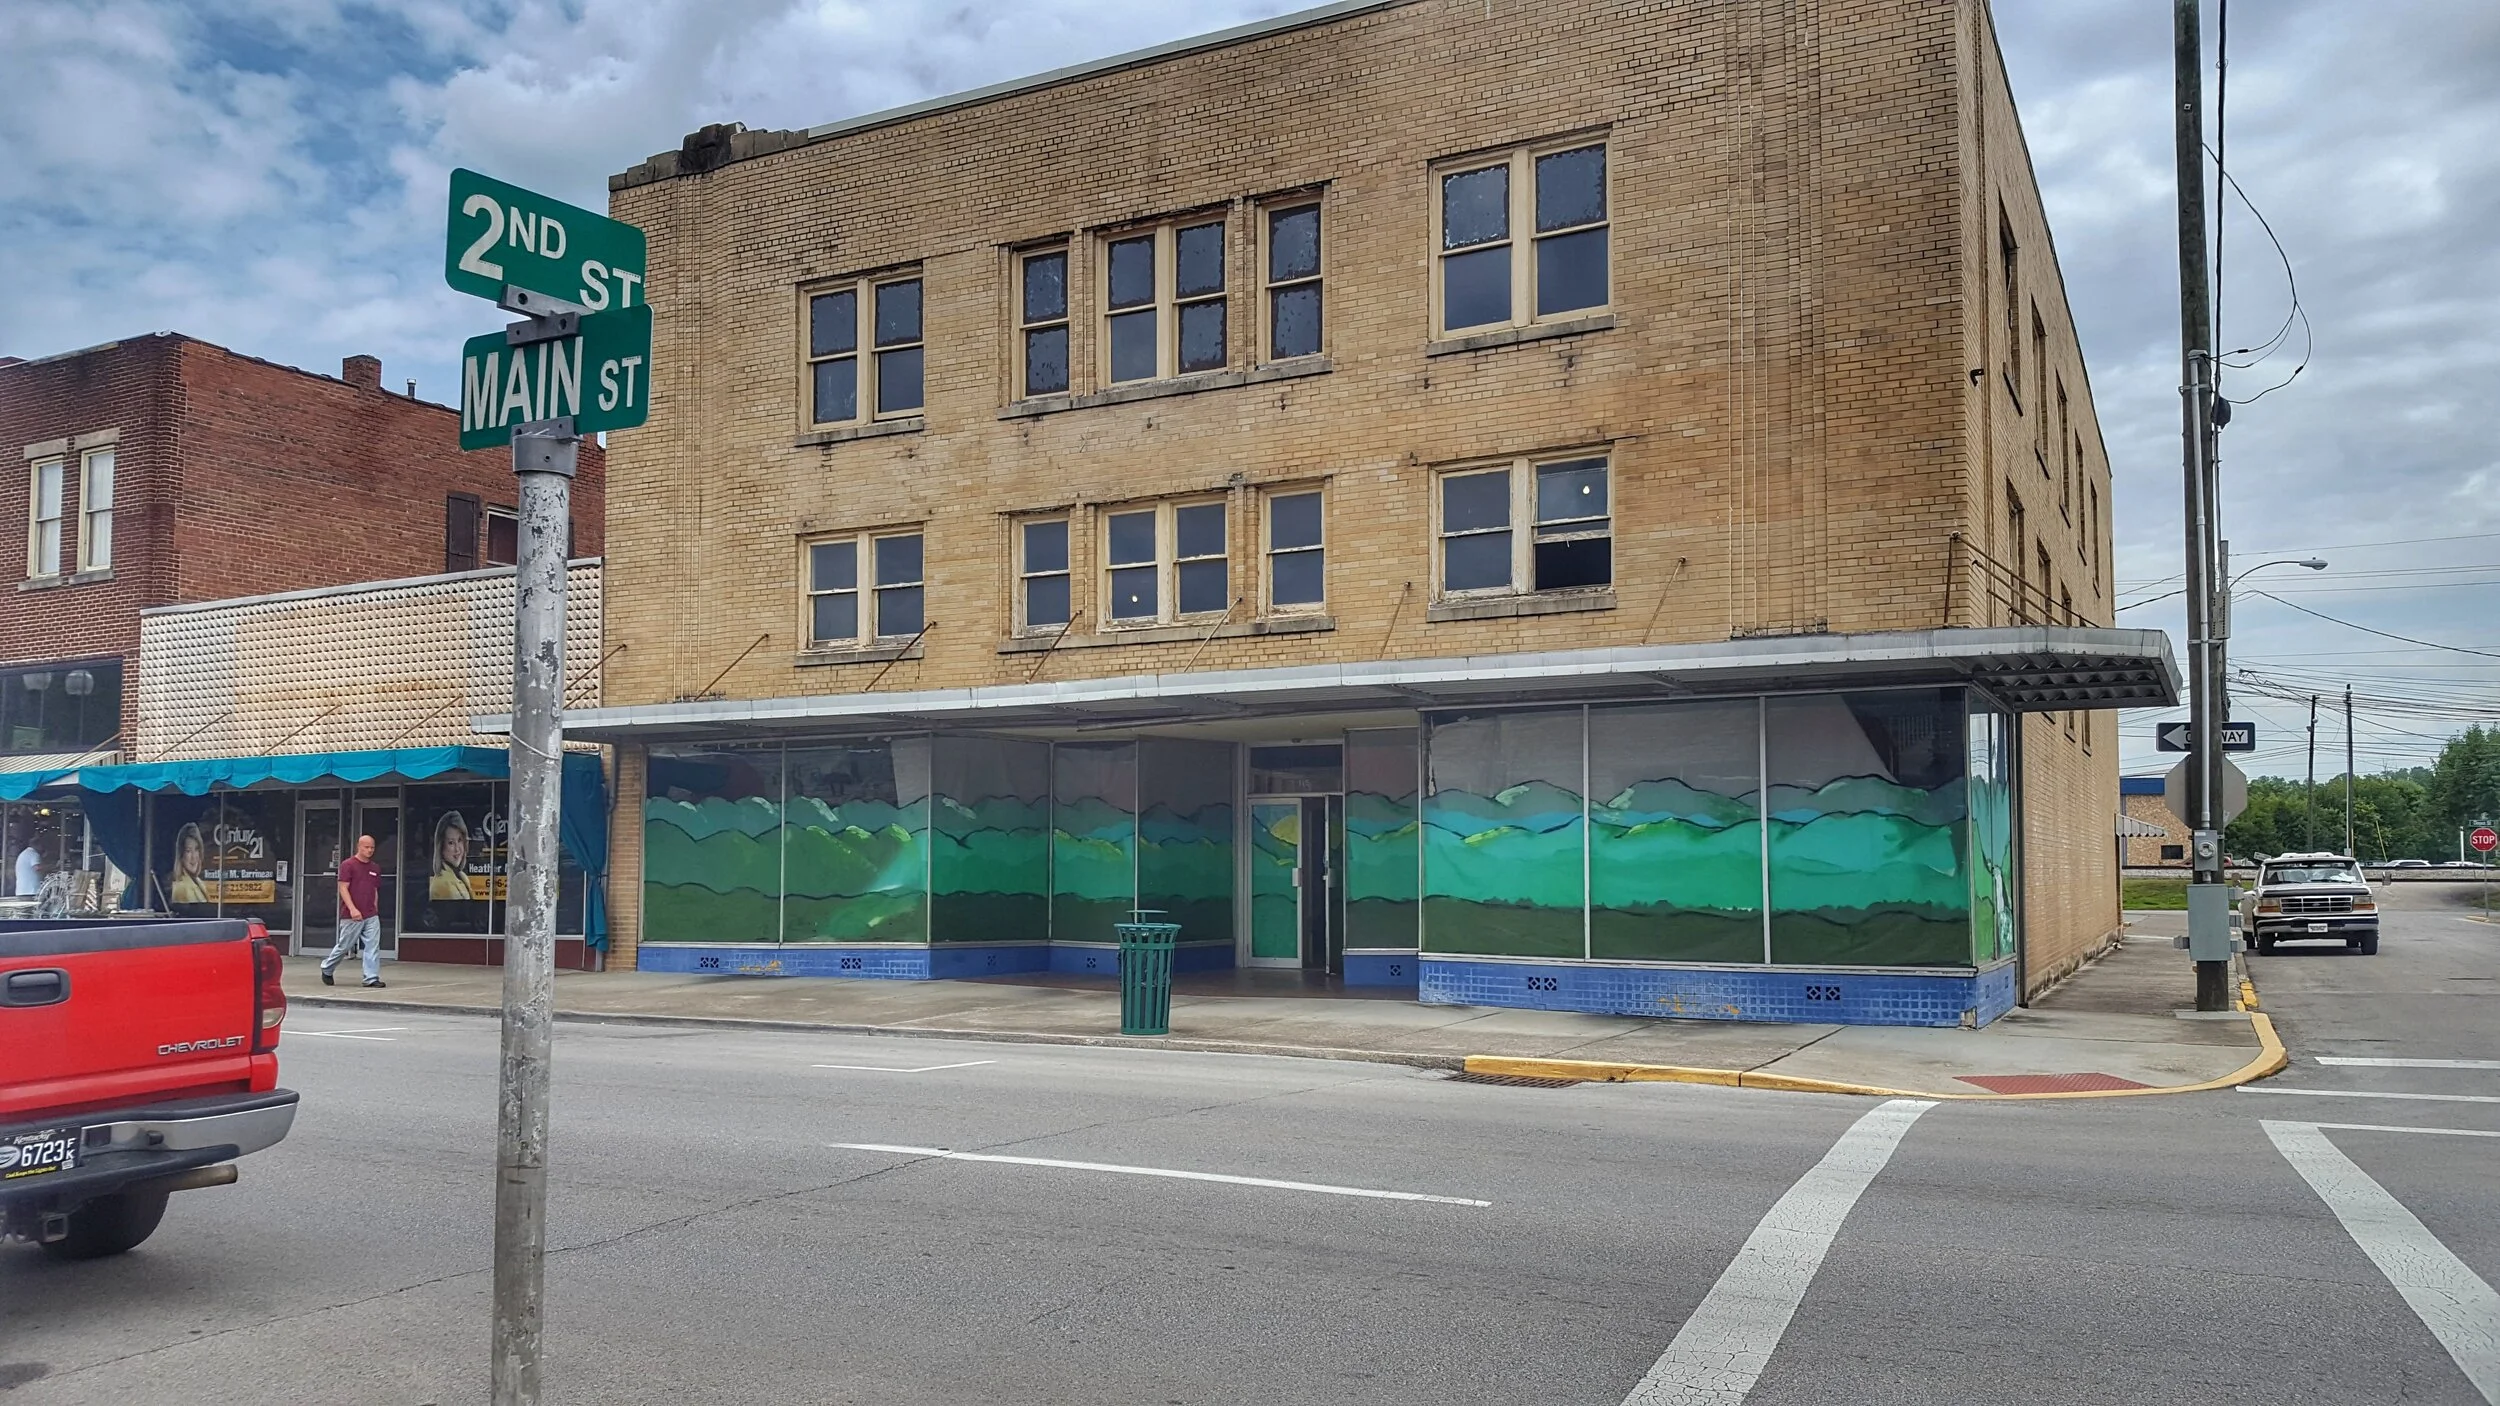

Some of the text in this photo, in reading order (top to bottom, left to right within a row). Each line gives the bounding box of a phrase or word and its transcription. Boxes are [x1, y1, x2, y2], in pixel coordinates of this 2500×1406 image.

[458, 193, 641, 311] 2ND ST
[462, 336, 642, 433] MAIN ST
[213, 824, 263, 858] Cntury 21
[2472, 835, 2495, 844] STOP
[204, 869, 229, 879] Heath
[468, 863, 502, 873] Heathr
[158, 1035, 246, 1056] CHEVROLET
[13, 1132, 51, 1145] Kentucky
[21, 1139, 66, 1167] 6723
